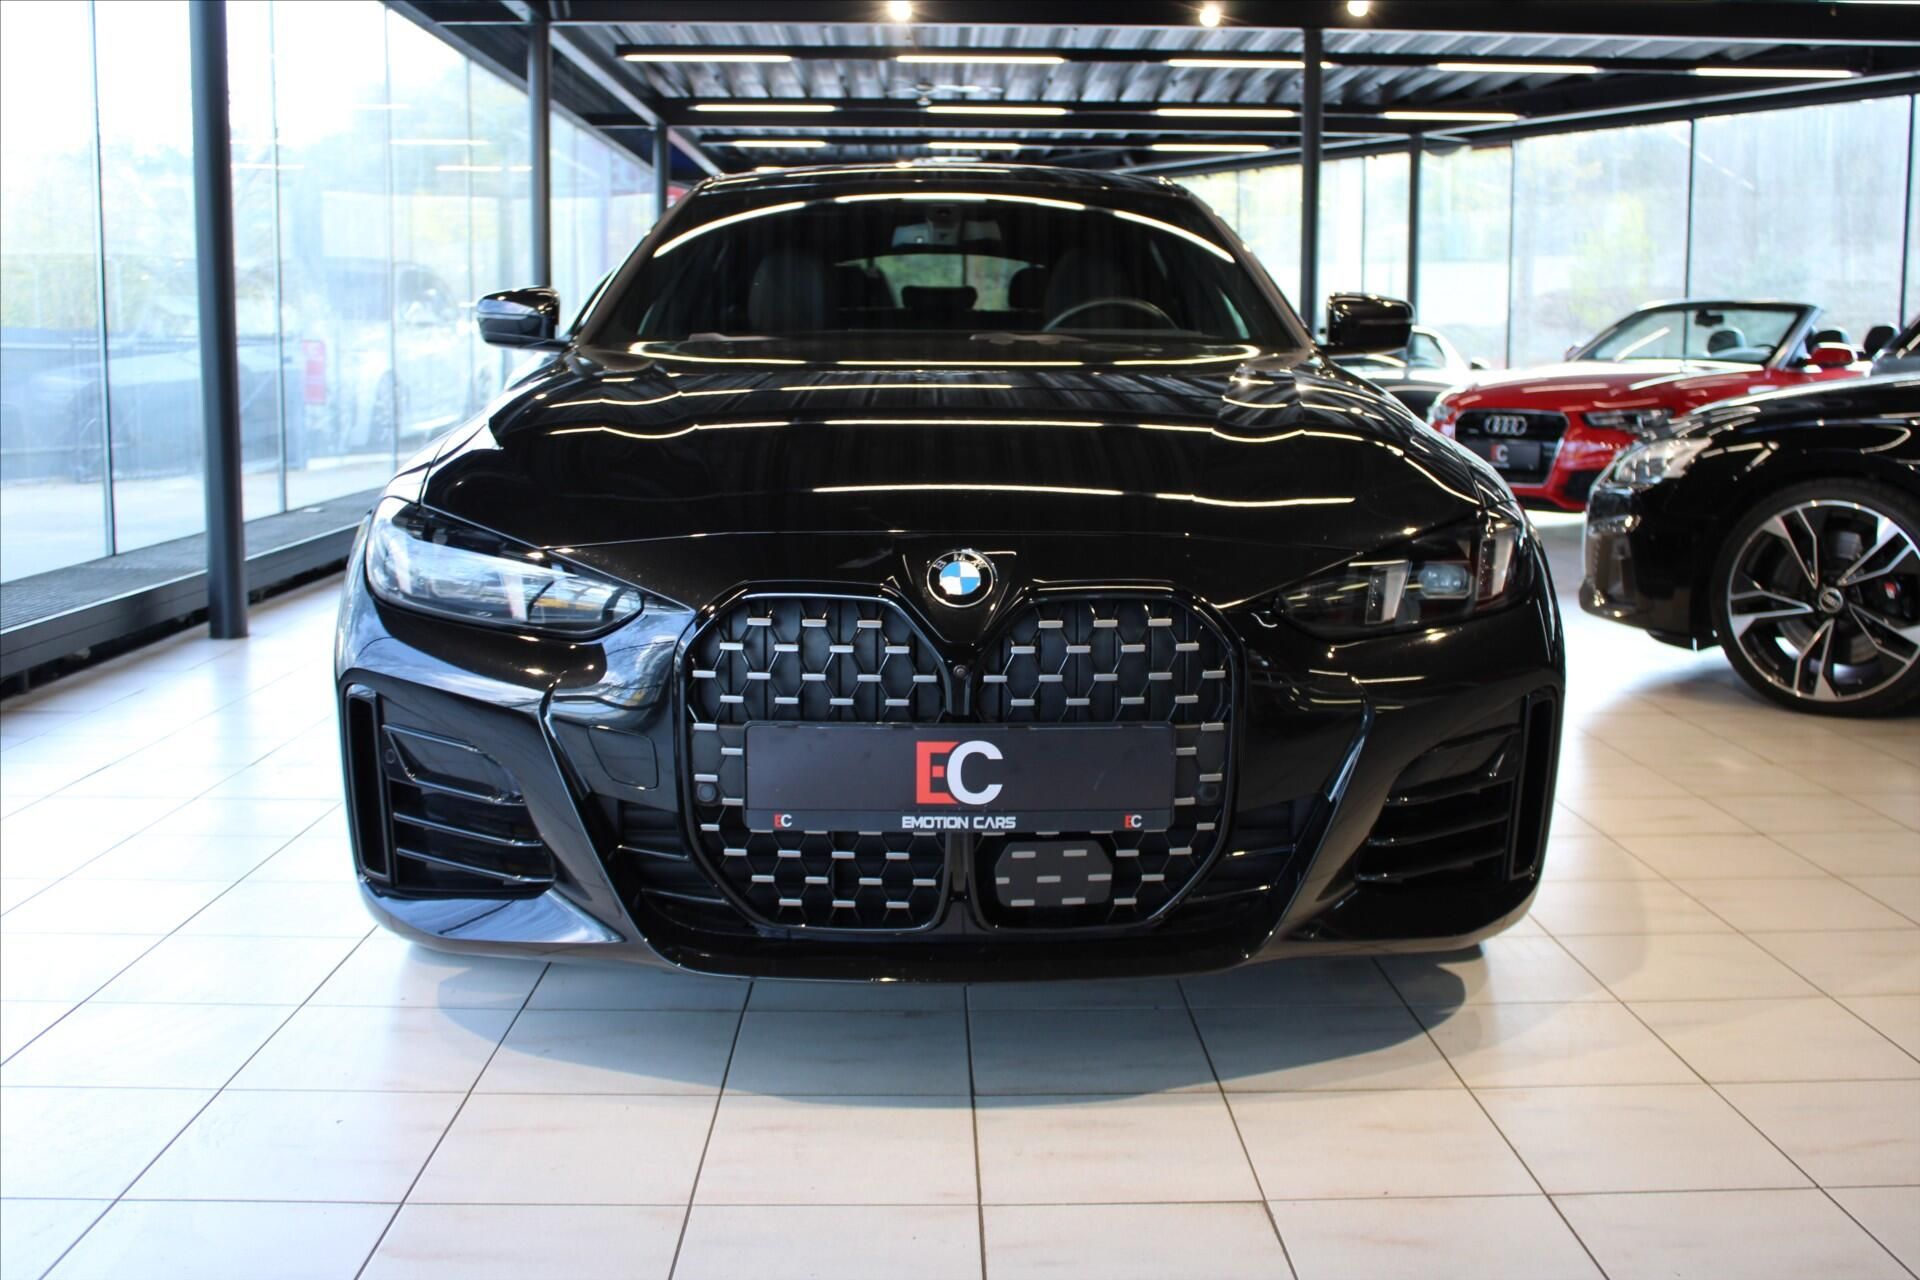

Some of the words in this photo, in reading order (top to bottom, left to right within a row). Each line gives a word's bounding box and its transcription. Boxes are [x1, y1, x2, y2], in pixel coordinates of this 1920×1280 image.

[916, 740, 1004, 805] EC
[774, 814, 792, 828] EC
[902, 815, 970, 829] EMOTION
[973, 816, 1017, 829] CARS
[1124, 814, 1142, 828] EC
